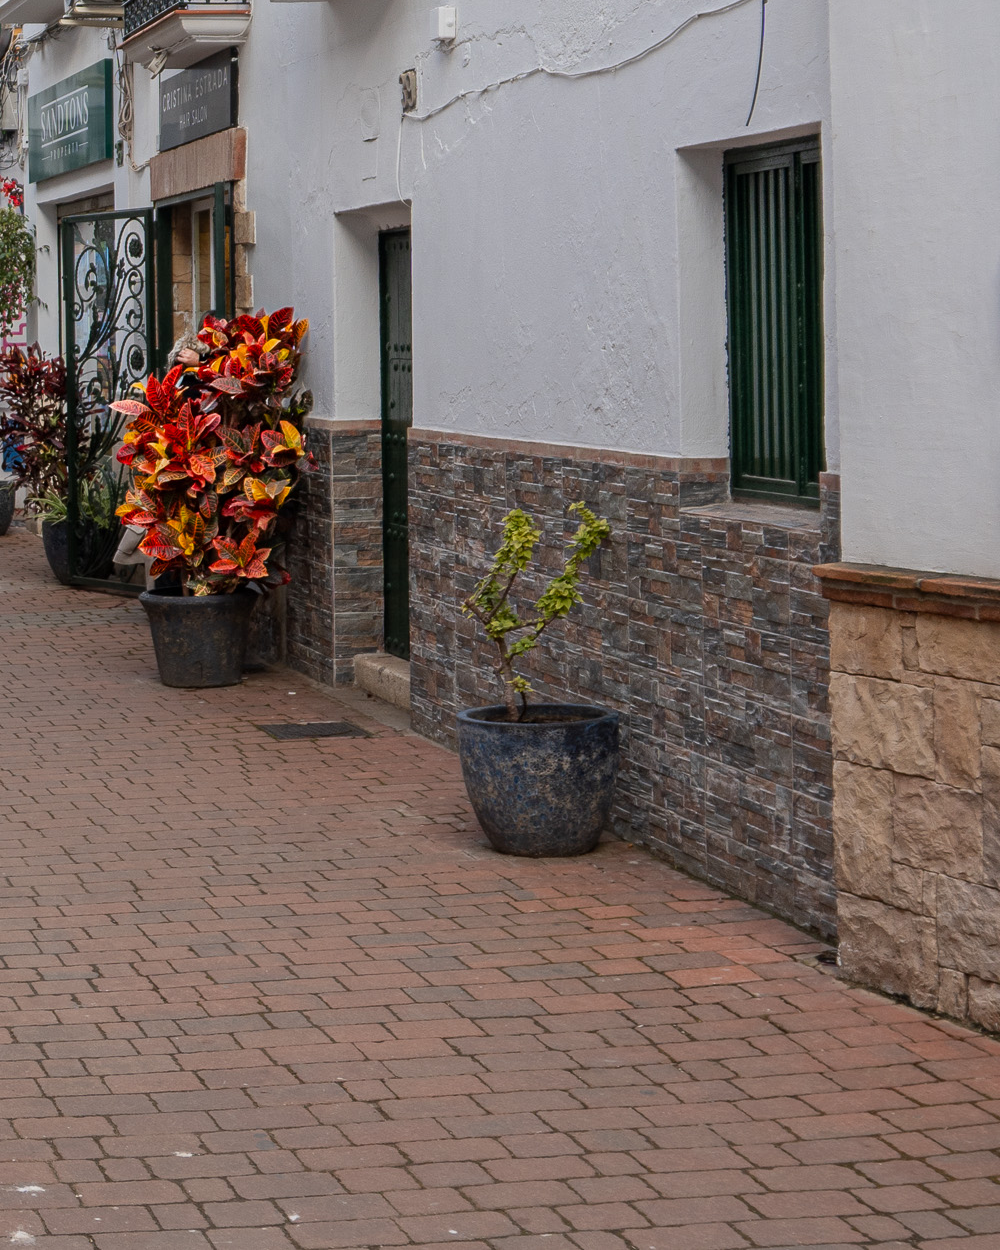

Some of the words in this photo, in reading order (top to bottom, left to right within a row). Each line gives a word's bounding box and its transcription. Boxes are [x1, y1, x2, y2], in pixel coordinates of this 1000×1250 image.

[162, 85, 193, 113] CRISTINA
[195, 71, 229, 99] ESTRADA
[41, 91, 89, 142] SANDTONS
